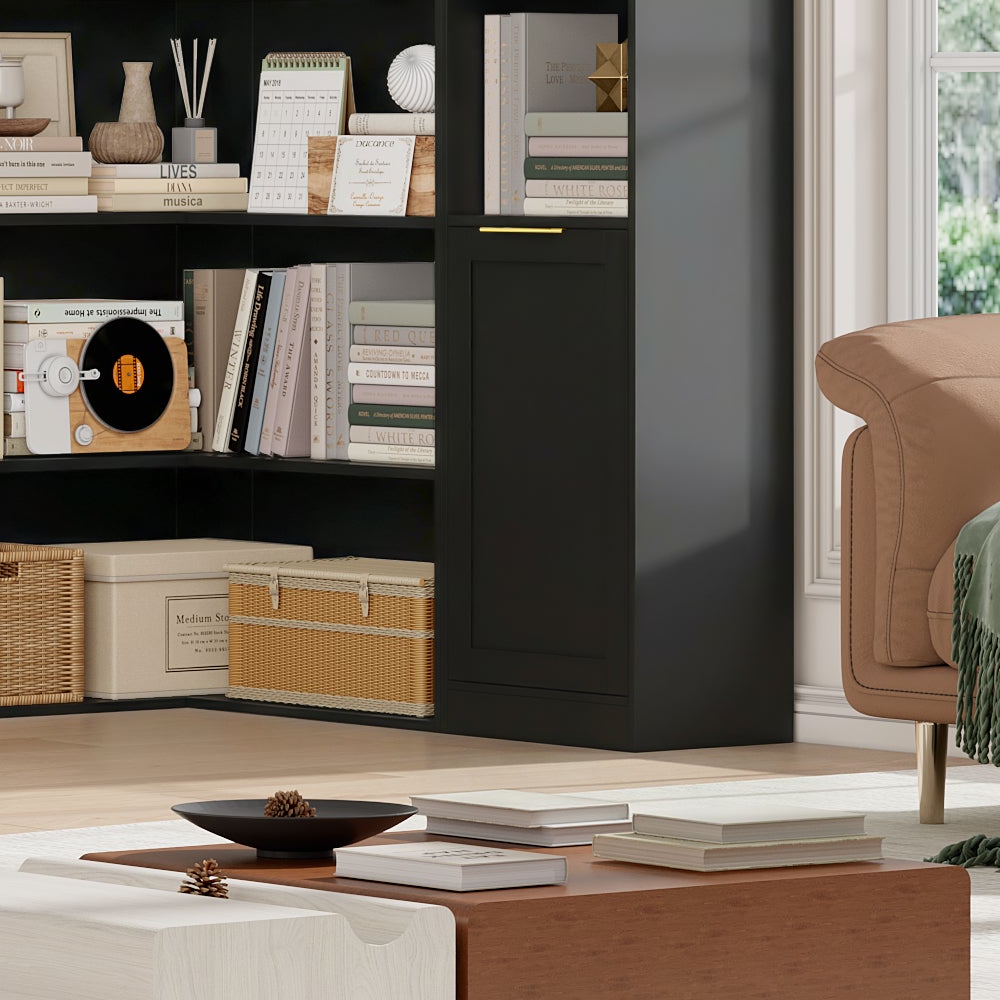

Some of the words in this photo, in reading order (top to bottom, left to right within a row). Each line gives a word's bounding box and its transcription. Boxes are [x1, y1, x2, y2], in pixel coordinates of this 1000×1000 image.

[160, 164, 197, 179] LIVES
[553, 184, 596, 197] WHITE
[5, 200, 53, 209] BAXTER-WRIGHT
[163, 195, 203, 207] musica
[254, 285, 265, 301] Life
[64, 308, 85, 318] Home
[86, 308, 94, 317] at
[96, 306, 147, 318] Impressionists
[149, 308, 162, 317] The
[248, 302, 263, 338] Drawing
[326, 292, 334, 353] GLASS
[374, 329, 399, 342] RED
[223, 330, 243, 390] WINTER
[240, 363, 251, 385] ROBIN
[365, 369, 400, 379] COUNTDOWN
[402, 370, 409, 380] TO
[411, 370, 429, 381] MECCA
[237, 385, 247, 409] BLACK
[326, 368, 335, 437] SWORD
[375, 431, 416, 445] WHITE
[176, 613, 212, 625] Medium
